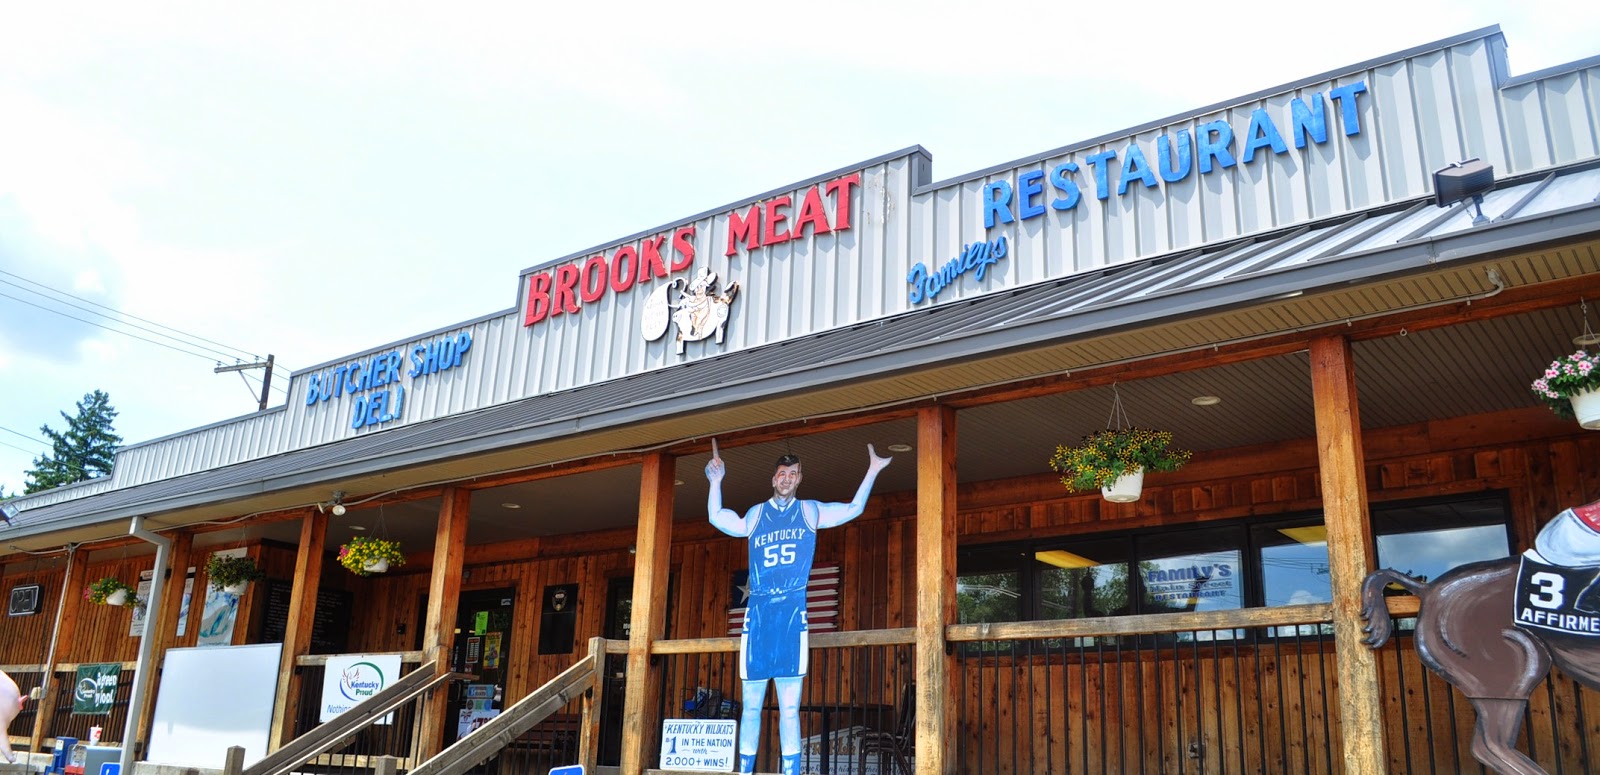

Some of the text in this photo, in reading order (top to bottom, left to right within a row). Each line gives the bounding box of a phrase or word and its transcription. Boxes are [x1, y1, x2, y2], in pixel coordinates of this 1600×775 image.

[982, 80, 1367, 230] RESTAURANT
[523, 173, 860, 327] BROOKS MEAT
[306, 331, 472, 406] BUTCHER SHOP
[352, 385, 405, 429] DELI
[754, 527, 806, 549] KENTUCKY
[763, 543, 797, 568] 55
[1529, 571, 1565, 610] 3
[350, 681, 380, 690] Kentucky
[355, 688, 374, 696] Proud
[665, 724, 735, 735] KENTUCKY WILDCATS
[681, 738, 690, 747] IN
[691, 738, 706, 747] THE
[706, 738, 733, 748] NATION
[703, 757, 729, 768] WINS!
